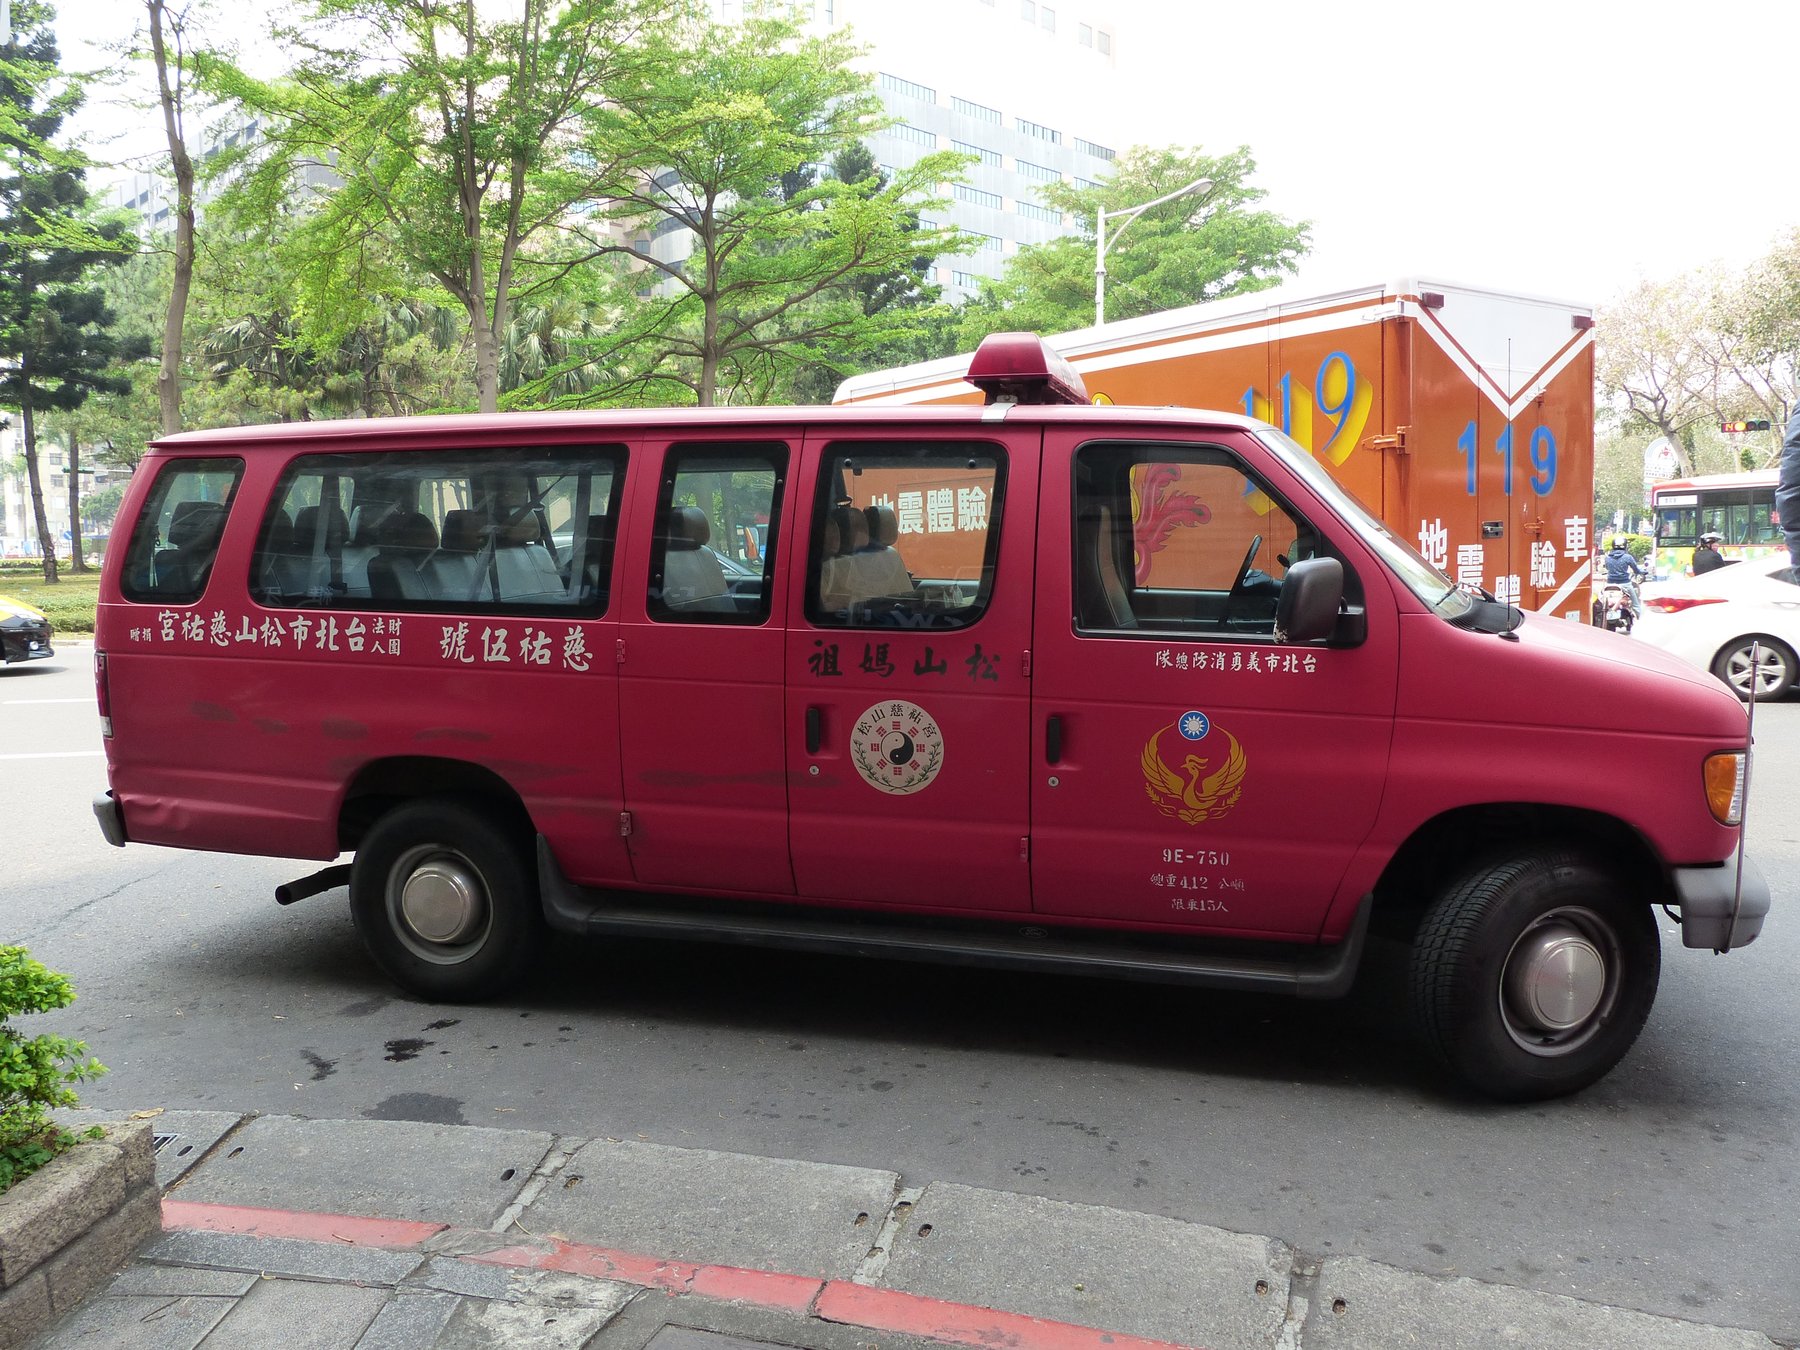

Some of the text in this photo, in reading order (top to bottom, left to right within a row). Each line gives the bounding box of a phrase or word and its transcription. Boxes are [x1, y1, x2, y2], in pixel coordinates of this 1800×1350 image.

[1457, 420, 1557, 497] 119
[440, 621, 593, 672] 慈祐伍號
[807, 639, 1001, 682] 松山媽祖
[1155, 649, 1317, 674] 台北市義勇消防總隊
[857, 703, 938, 739] 松山慈祐宮
[1163, 848, 1230, 866] 9E-750
